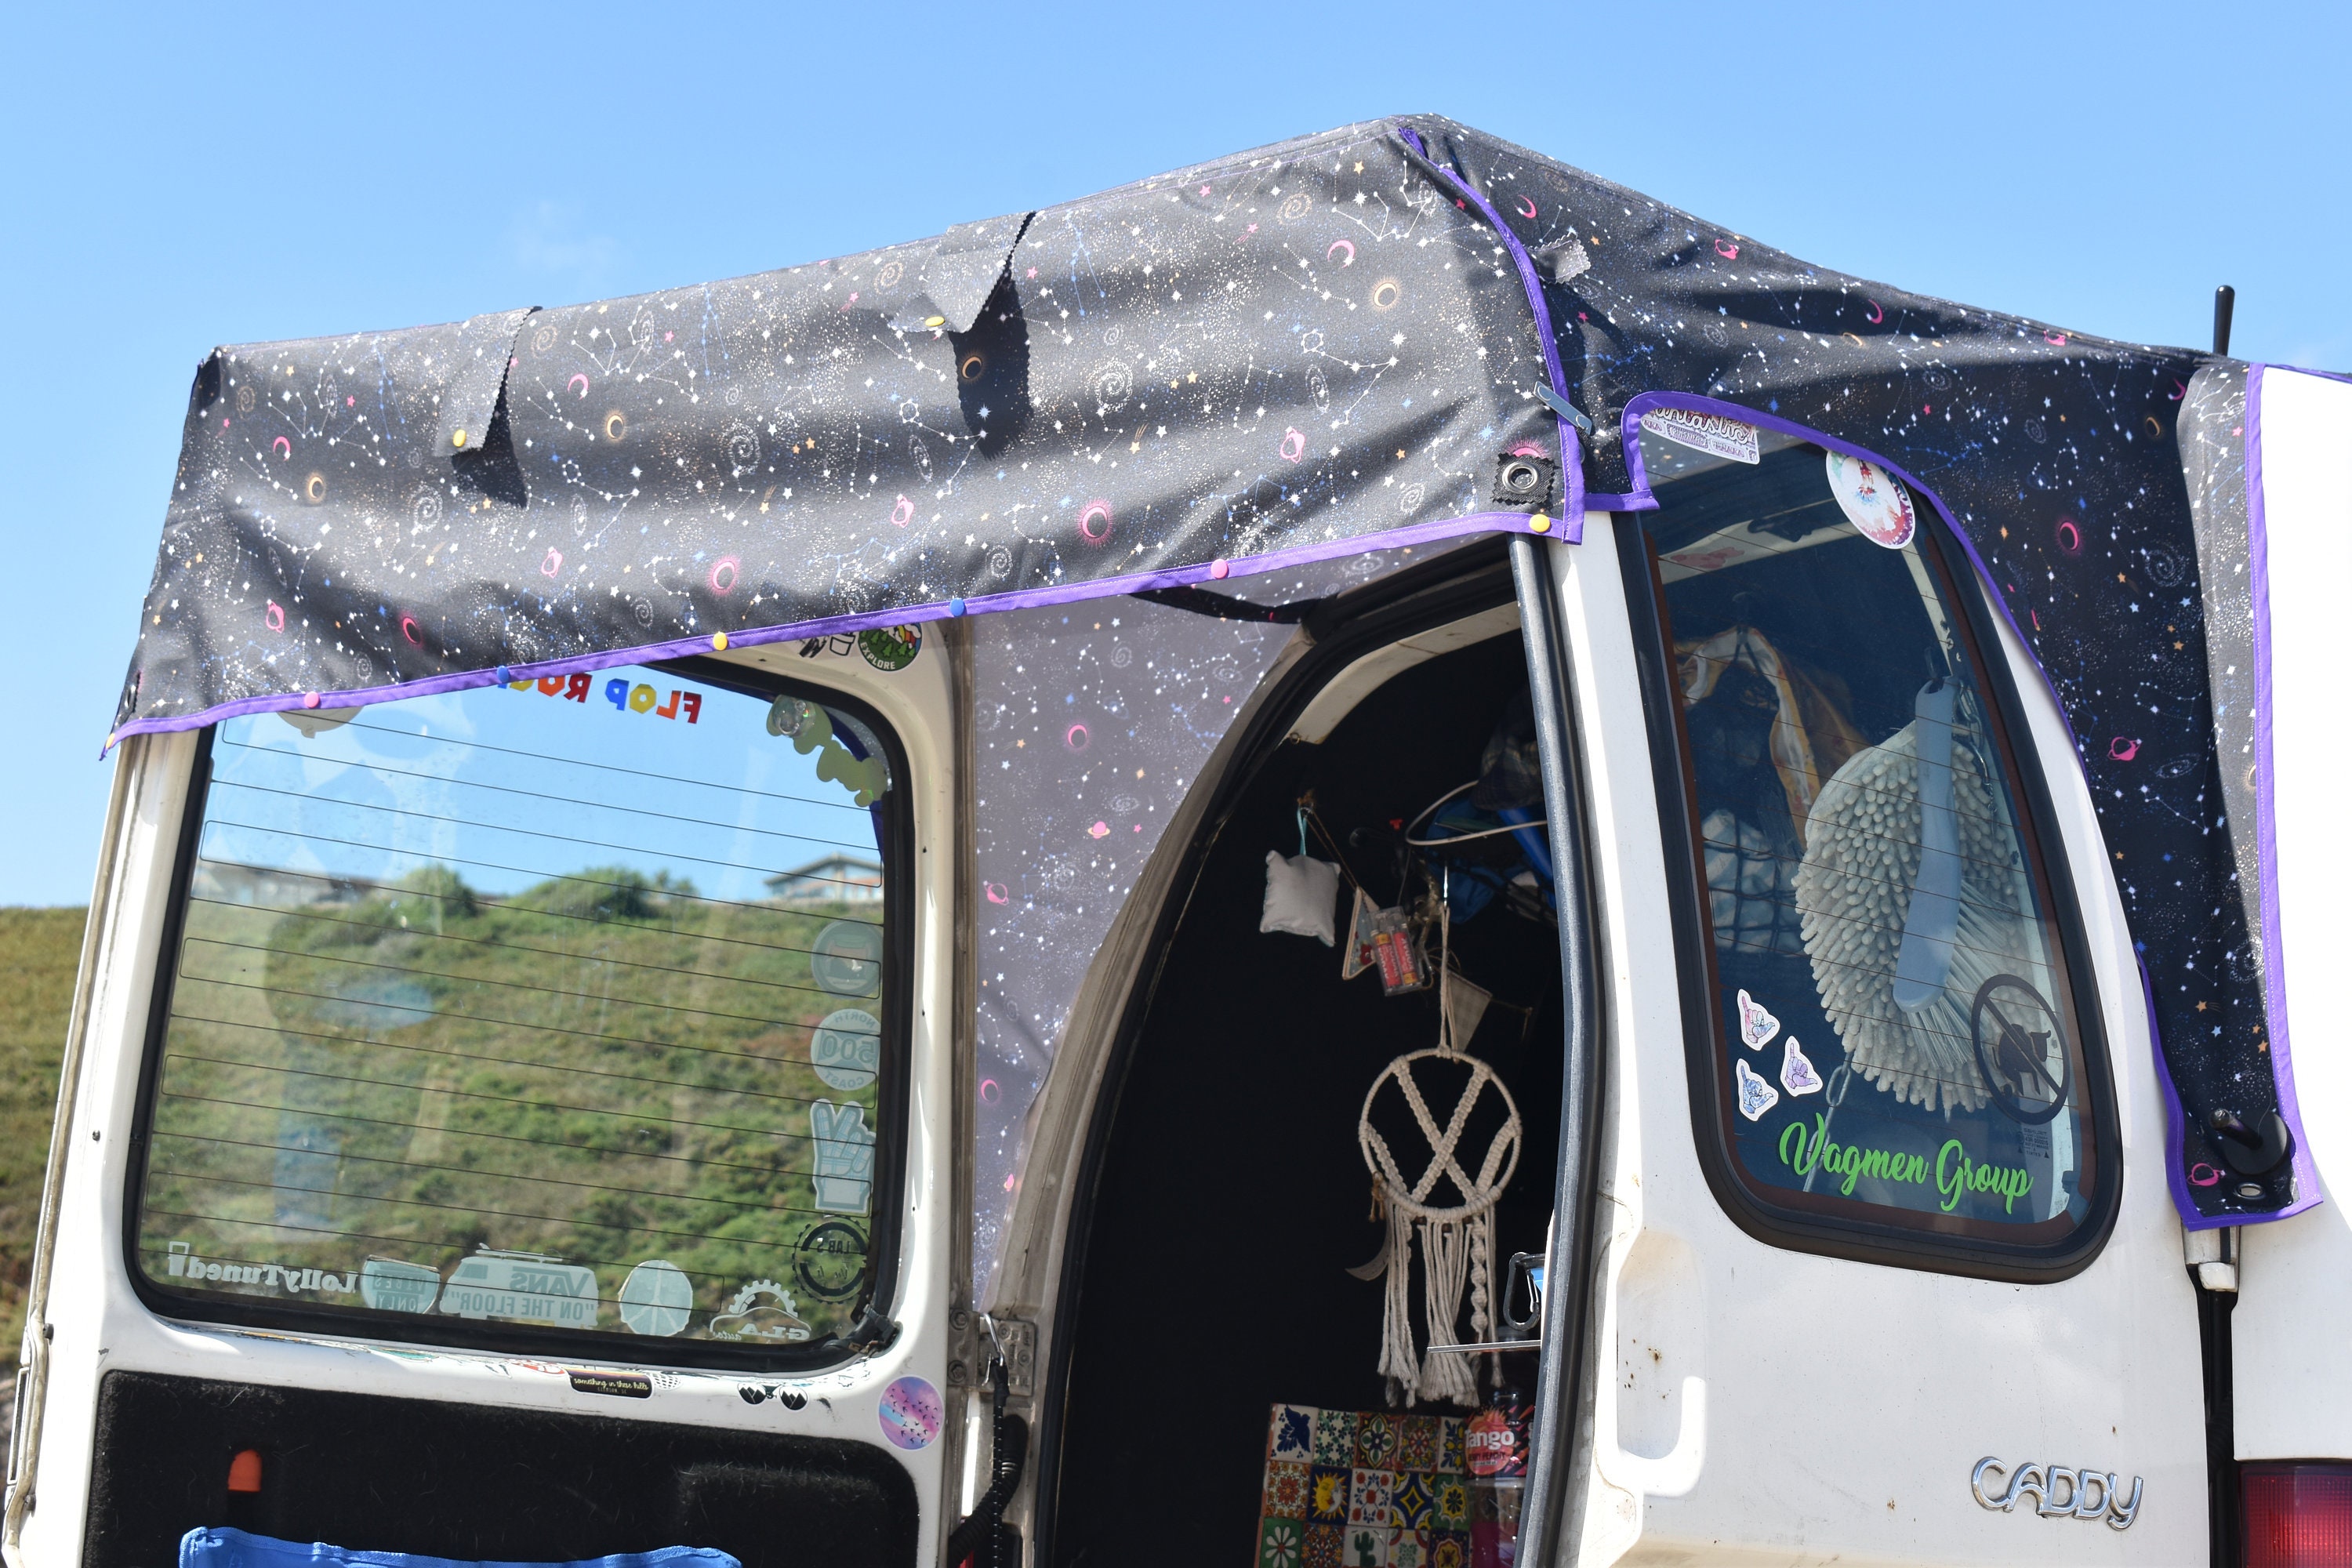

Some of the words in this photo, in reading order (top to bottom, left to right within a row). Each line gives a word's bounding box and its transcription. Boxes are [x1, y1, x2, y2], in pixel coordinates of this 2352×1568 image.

[1653, 408, 1749, 445] antastic
[860, 641, 896, 670] EXPLORE
[1779, 1112, 1929, 1196] Vagmen
[1935, 1138, 2034, 1215] Group
[574, 1377, 608, 1389] something
[633, 1381, 649, 1391] hills
[1465, 1428, 1515, 1450] Tango
[1970, 1455, 2143, 1532] CADDY
